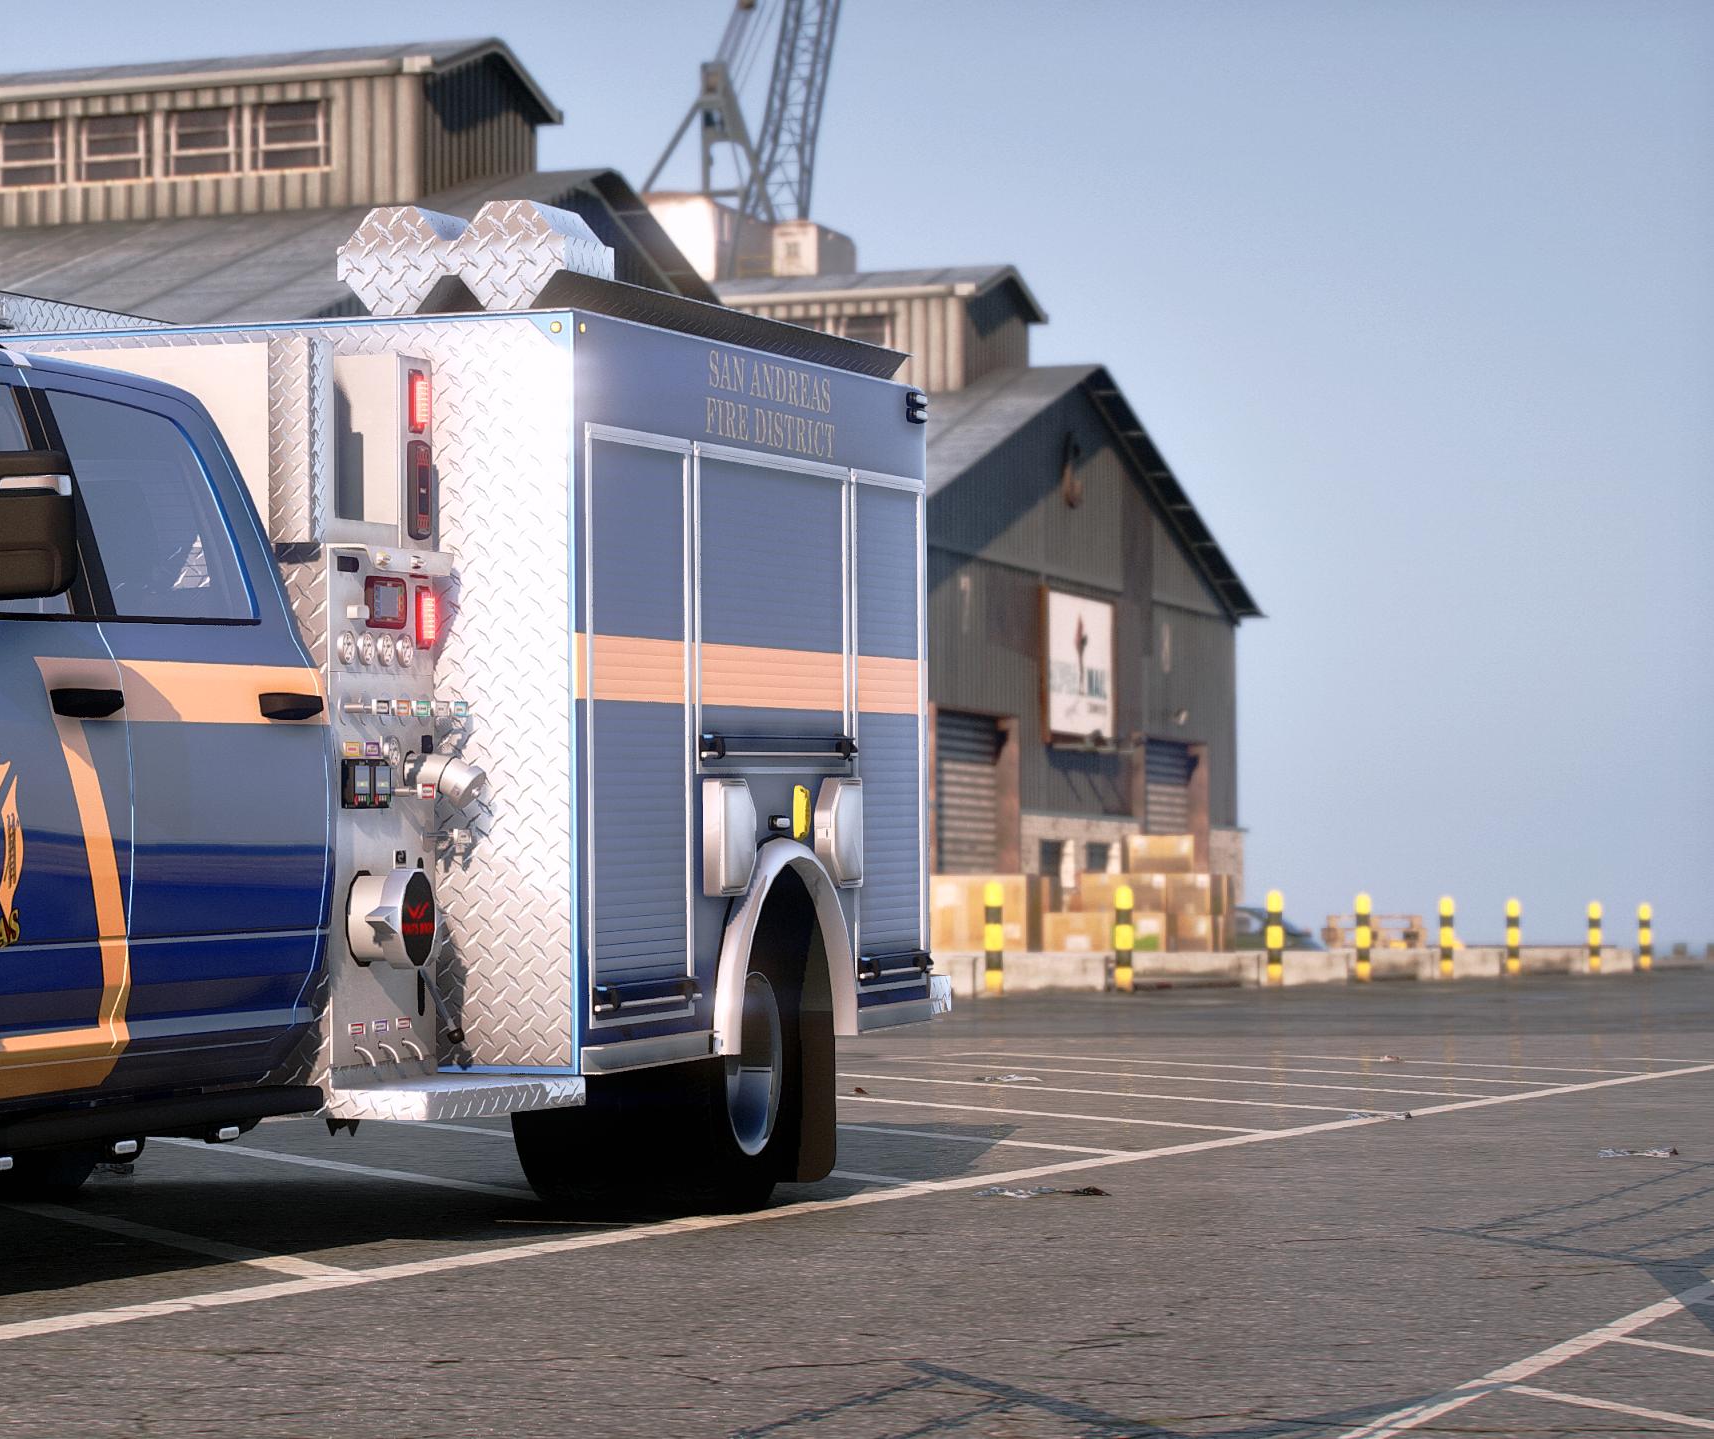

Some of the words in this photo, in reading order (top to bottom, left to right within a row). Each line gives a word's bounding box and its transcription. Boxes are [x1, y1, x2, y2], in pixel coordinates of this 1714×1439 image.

[709, 350, 746, 393] SAN
[750, 360, 831, 414] ANDREAS
[705, 397, 749, 441] FIRE
[754, 407, 835, 459] DISTRICT
